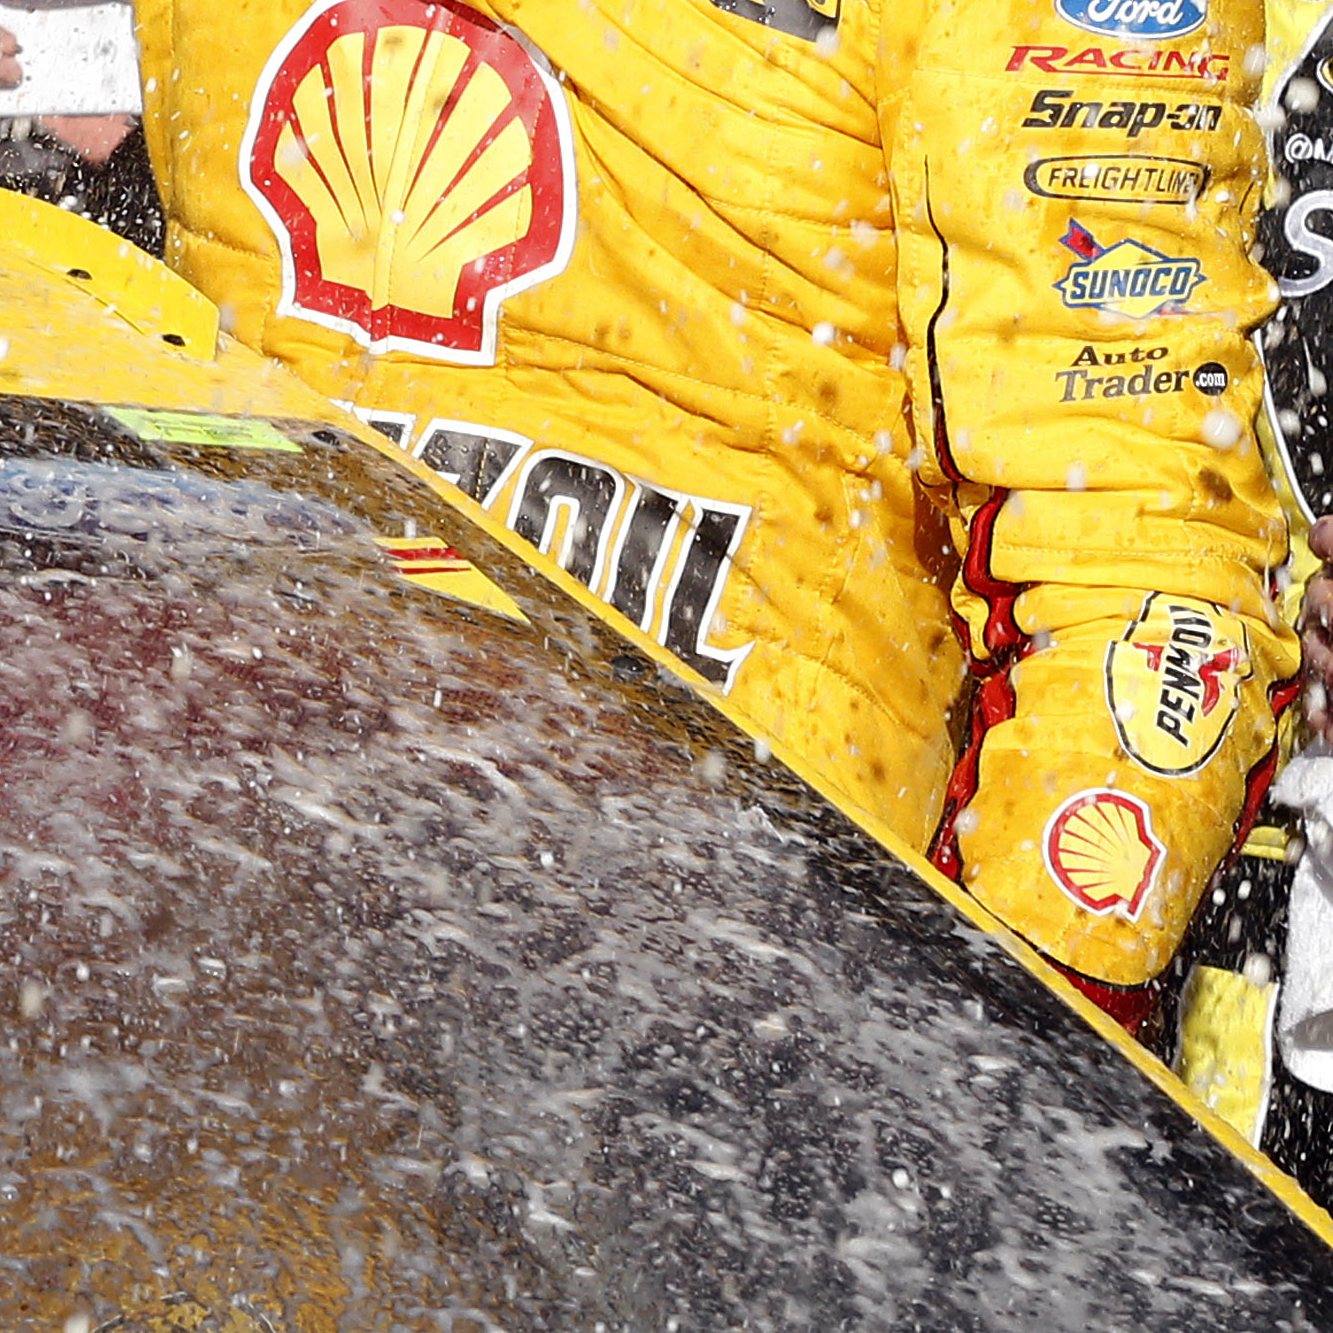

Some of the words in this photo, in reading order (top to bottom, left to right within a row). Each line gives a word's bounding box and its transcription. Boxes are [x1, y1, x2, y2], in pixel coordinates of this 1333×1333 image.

[1005, 45, 1230, 81] RACING
[1022, 90, 1222, 138] Snap-on
[1070, 266, 1193, 300] SUNOCO
[1070, 345, 1169, 368] Auto
[1055, 364, 1191, 403] Trader
[1195, 370, 1227, 388] .com
